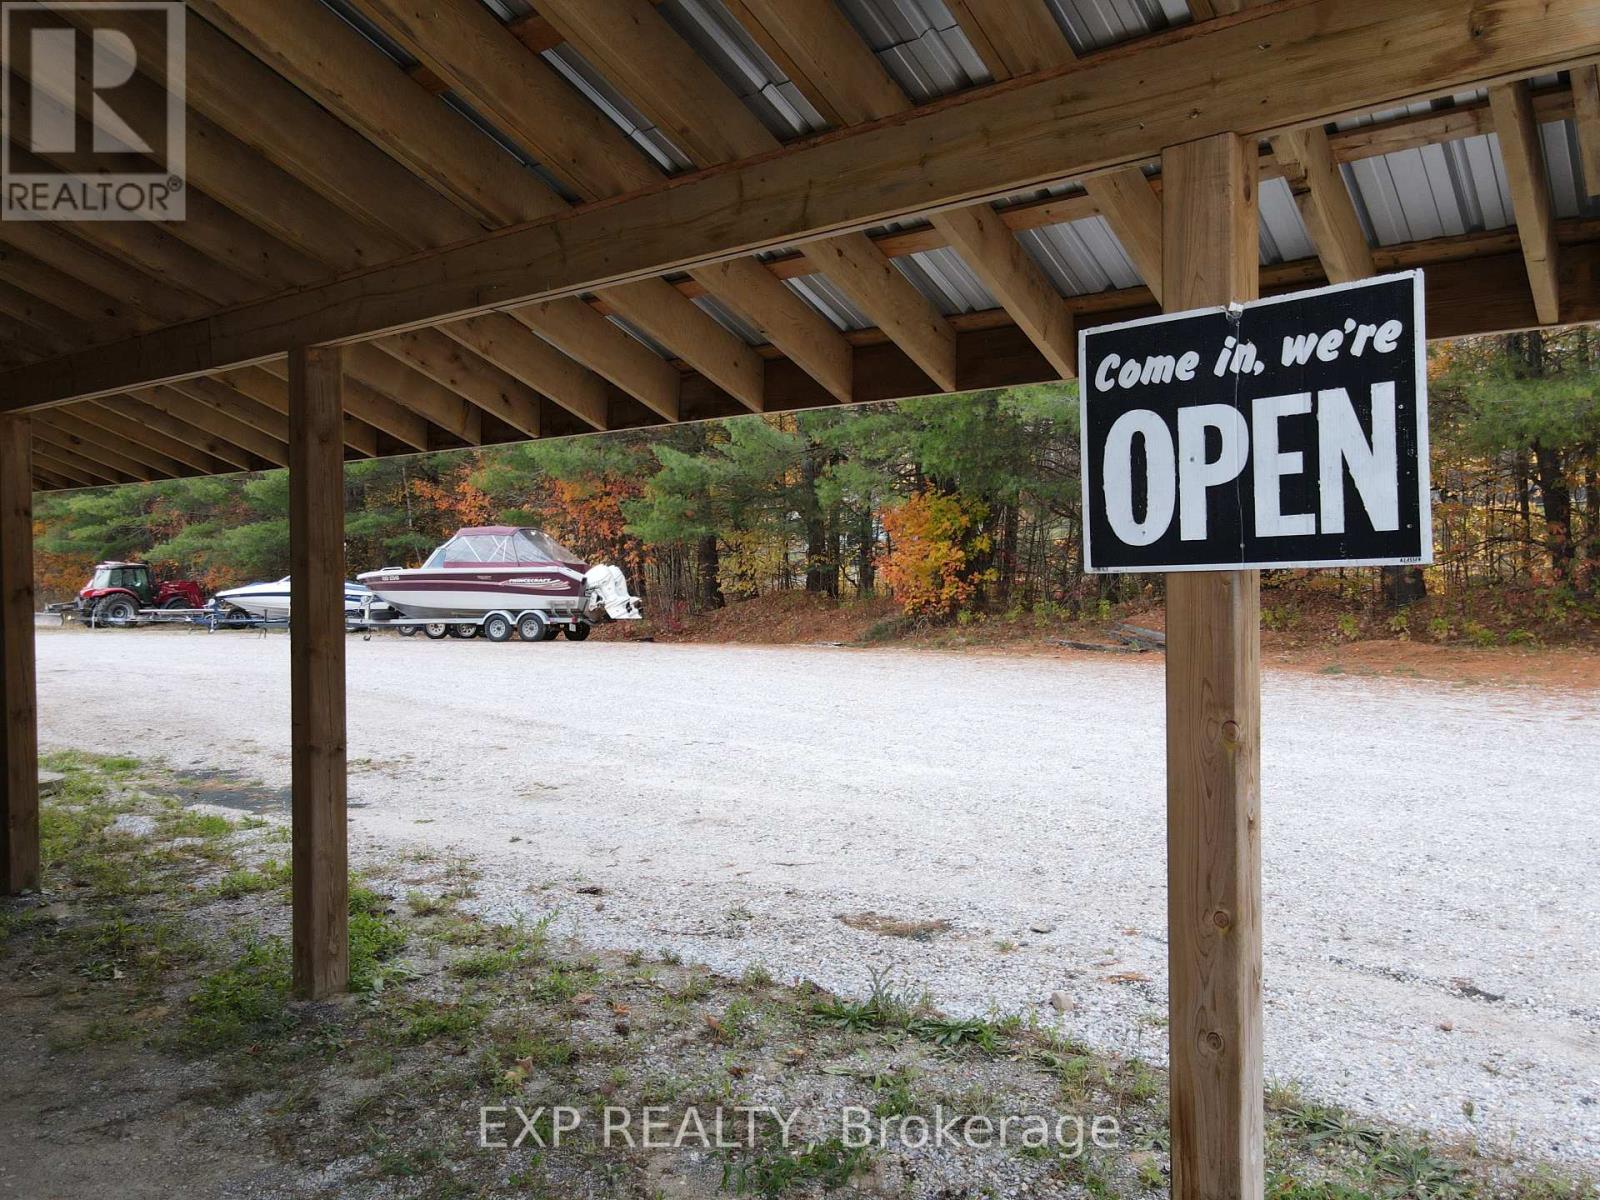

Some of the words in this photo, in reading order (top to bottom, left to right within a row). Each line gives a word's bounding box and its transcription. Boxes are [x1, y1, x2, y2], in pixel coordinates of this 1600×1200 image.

[1095, 351, 1200, 392] Come
[1213, 336, 1265, 377] in,
[1281, 318, 1403, 367] we're
[1103, 381, 1400, 547] OPEN
